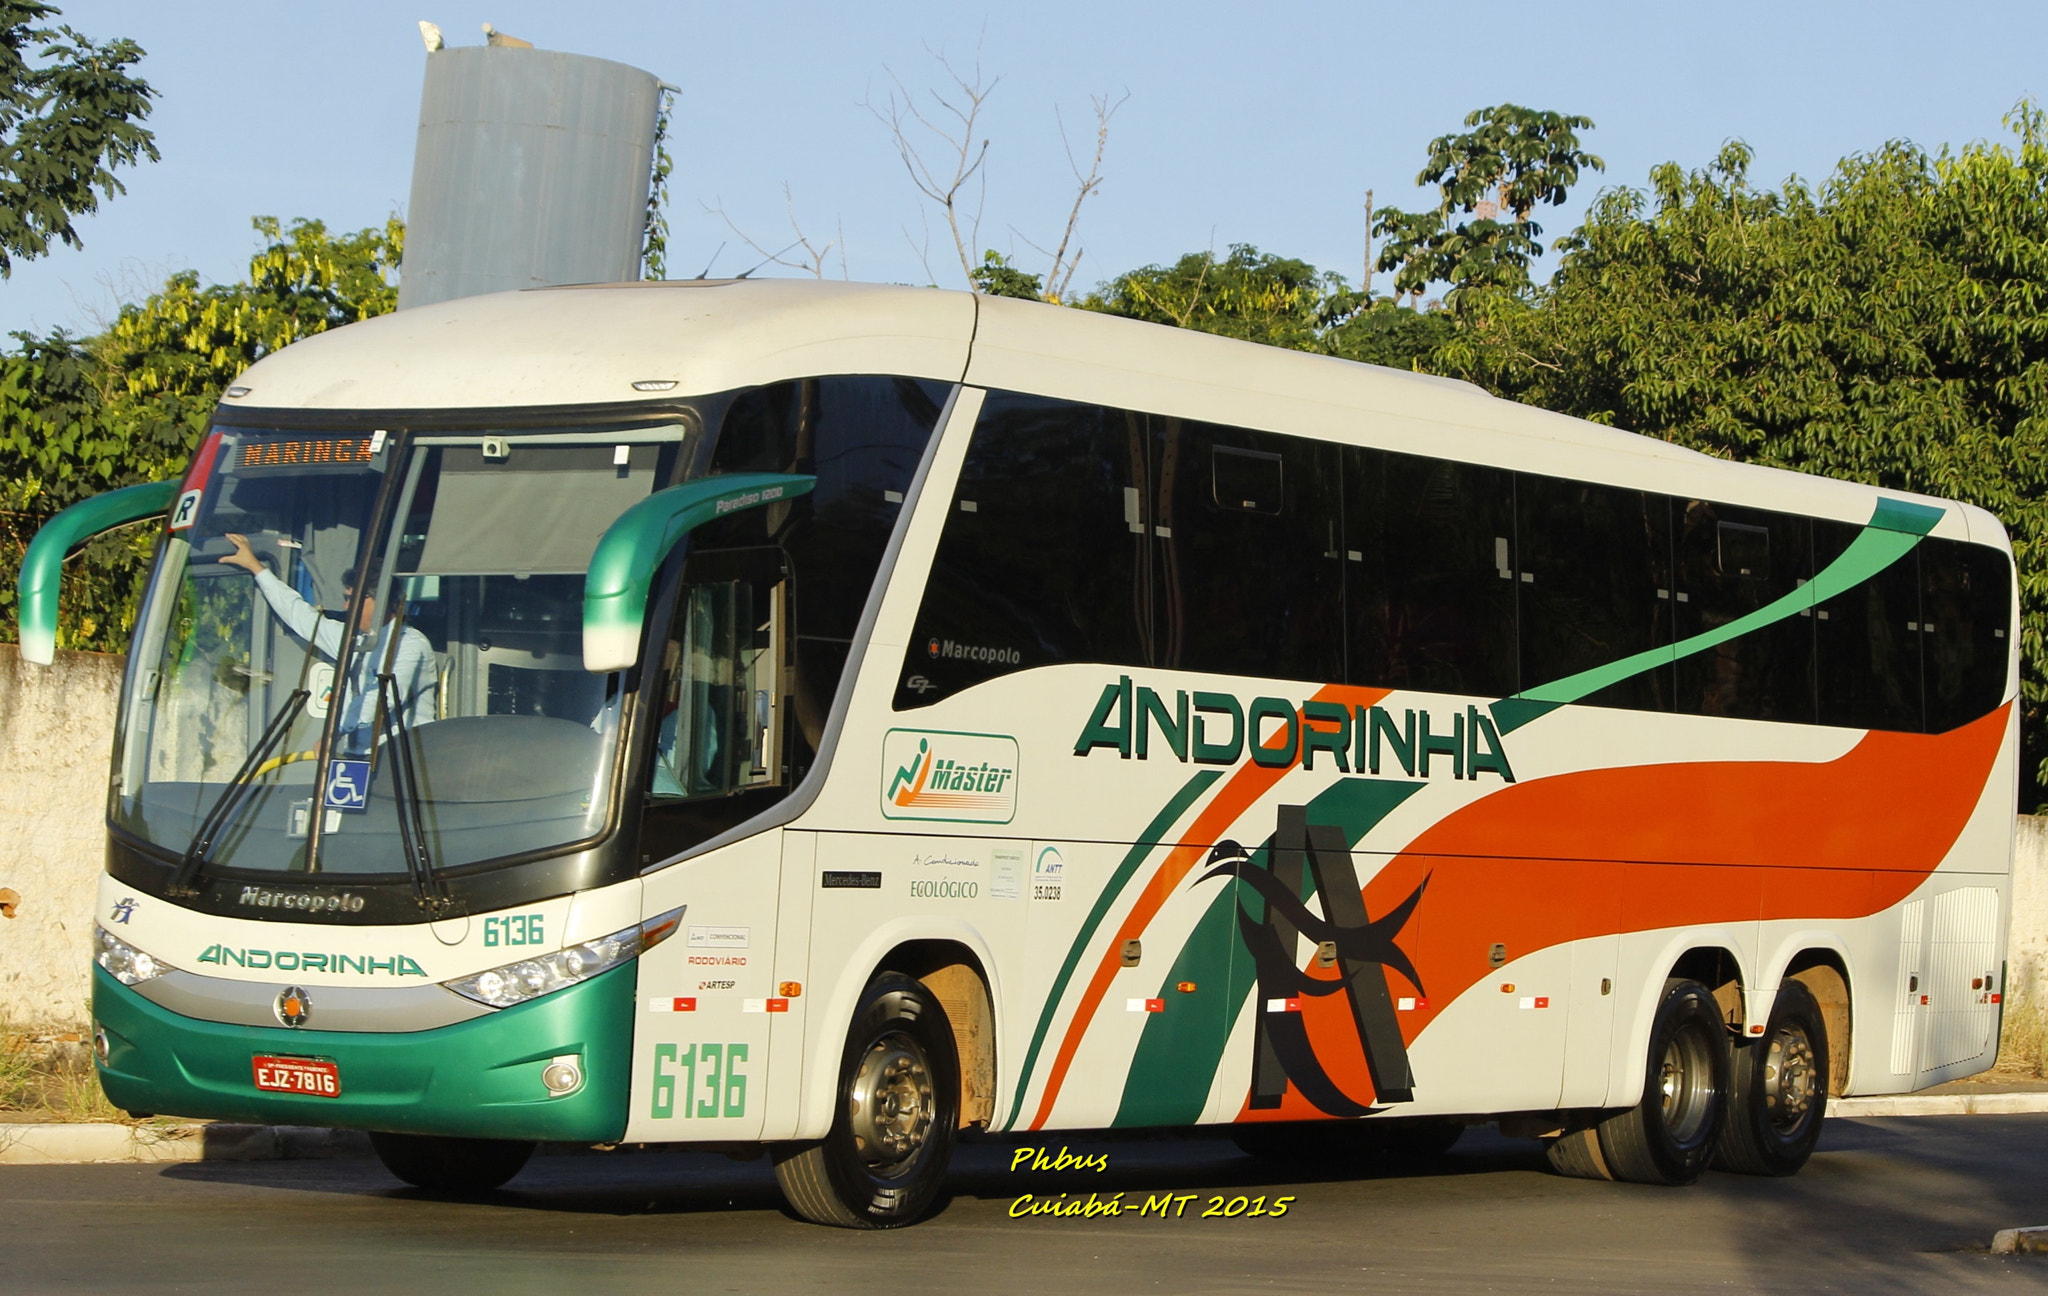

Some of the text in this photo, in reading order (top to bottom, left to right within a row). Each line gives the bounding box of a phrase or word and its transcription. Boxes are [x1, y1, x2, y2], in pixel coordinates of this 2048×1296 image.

[244, 439, 373, 466] MARINGA
[174, 495, 196, 523] R
[716, 492, 760, 514] Paradiso
[941, 639, 1021, 665] Marcopolo
[1073, 674, 1517, 783] ANDORINHA
[930, 759, 1013, 793] Master
[824, 872, 880, 887] Mercedes-Benz
[1045, 863, 1064, 873] ANTT
[239, 885, 365, 913] Marcopolo
[910, 876, 979, 898] ECOLÓGICO
[1033, 885, 1062, 901] 35.0238
[484, 914, 545, 947] 6136
[197, 943, 430, 978] ANDORINHA
[687, 955, 748, 966] RODOVIÁRIO
[705, 980, 736, 990] ARTESP
[258, 1068, 335, 1093] EJZ-7816
[651, 1043, 749, 1119] 6136
